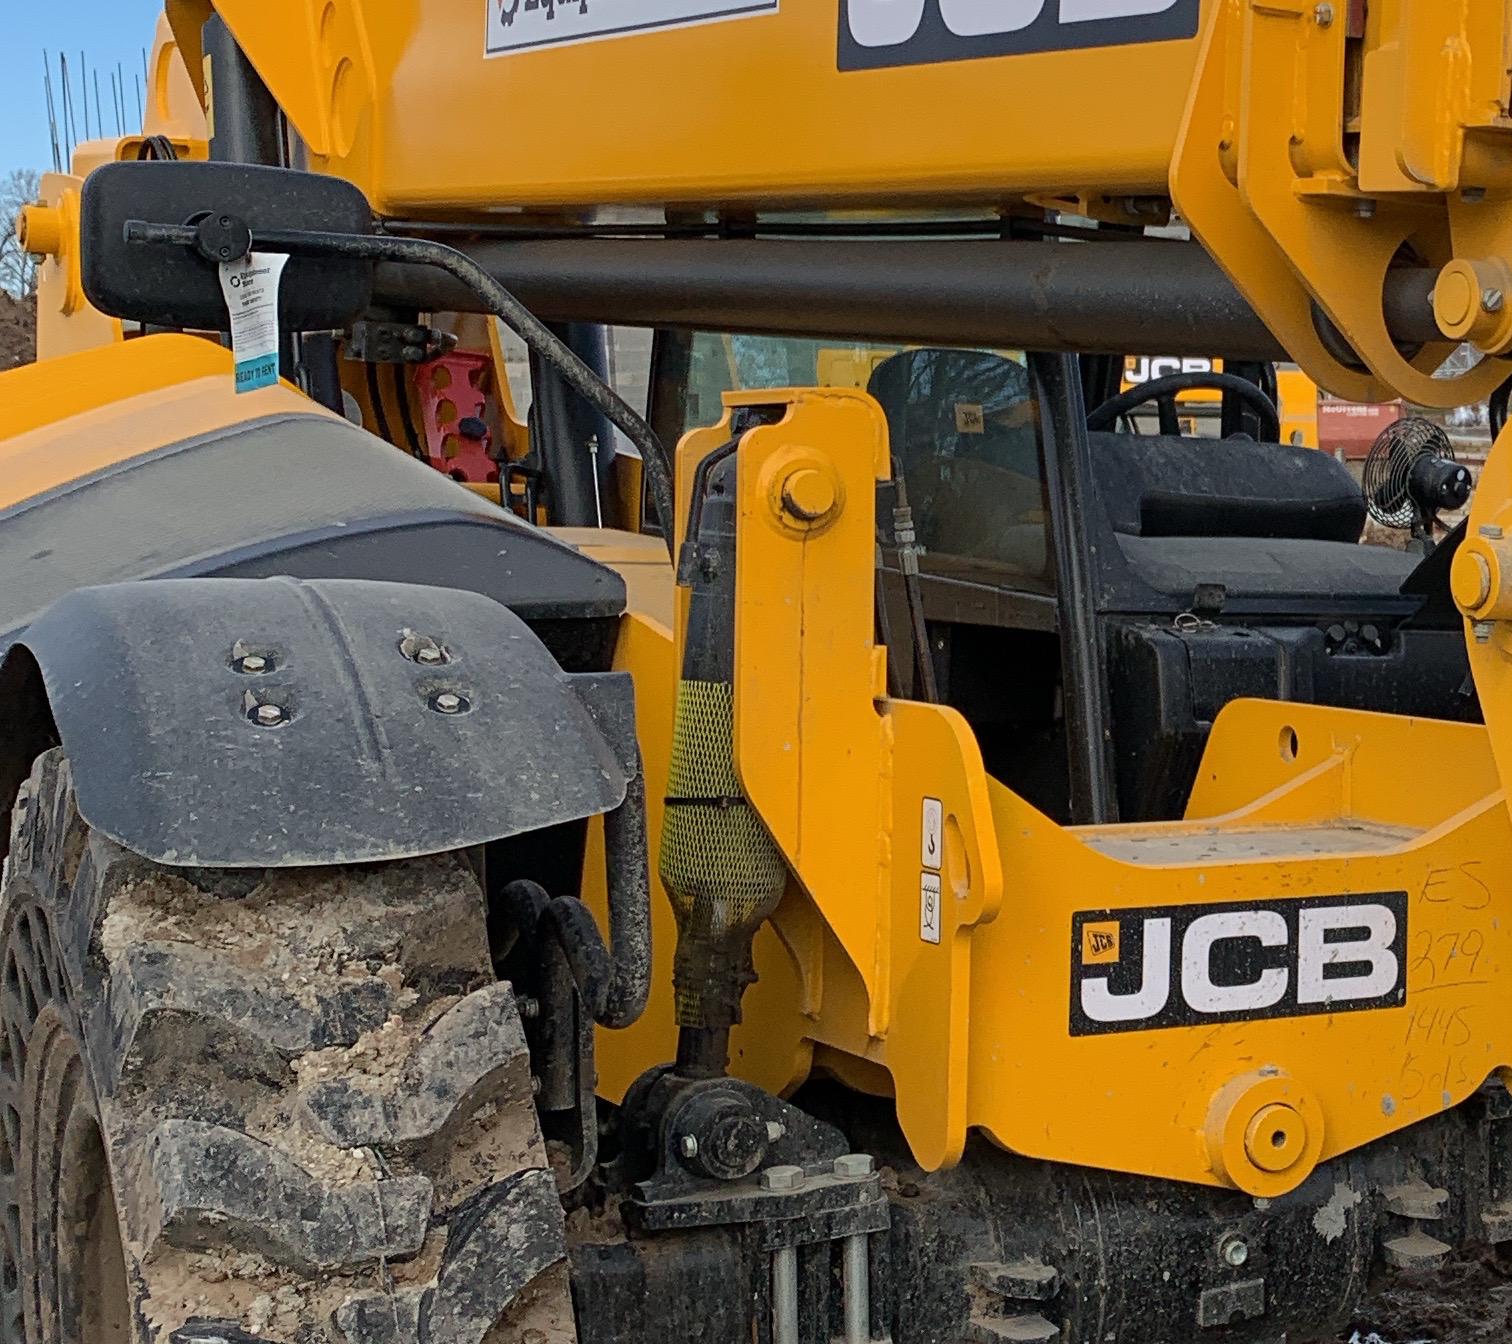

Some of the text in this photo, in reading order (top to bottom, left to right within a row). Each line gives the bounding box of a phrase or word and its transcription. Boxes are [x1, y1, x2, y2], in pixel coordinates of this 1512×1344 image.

[1418, 861, 1491, 910] ES
[1080, 904, 1399, 1022] JCB
[1090, 931, 1114, 954] JCB
[1411, 929, 1486, 983] 279
